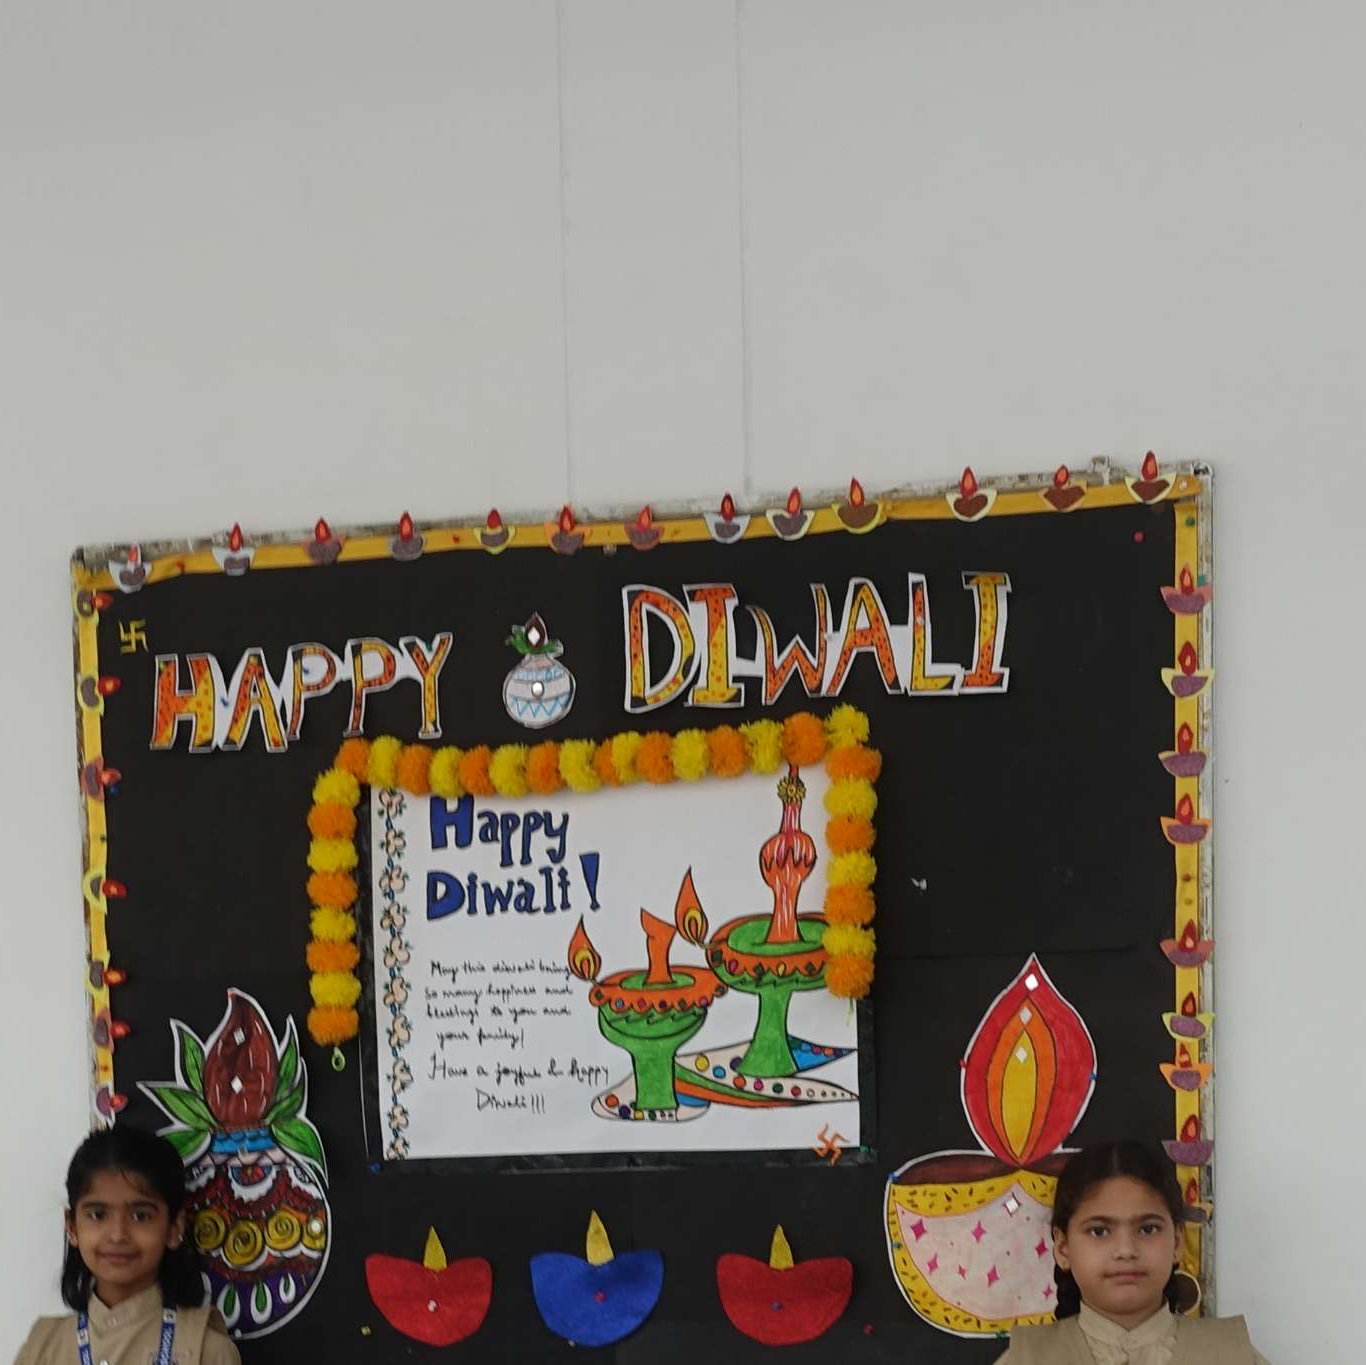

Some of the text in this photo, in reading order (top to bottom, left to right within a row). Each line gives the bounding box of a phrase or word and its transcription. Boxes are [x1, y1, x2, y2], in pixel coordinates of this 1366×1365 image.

[150, 571, 1012, 753] HAPPY DIWALI
[429, 792, 570, 867] Happy
[430, 960, 460, 984] May
[462, 960, 486, 974] this
[538, 959, 571, 982] bring
[442, 989, 483, 1005] many
[486, 982, 537, 1004] happiness
[544, 984, 573, 996] and
[490, 1004, 504, 1017] to
[508, 1006, 536, 1024] you
[543, 1003, 571, 1016] and
[436, 1031, 470, 1051] your
[426, 1051, 469, 1081] Have
[476, 1064, 489, 1077] a
[495, 1061, 542, 1086] joyful
[569, 1056, 610, 1088] happy
[160, 1325, 174, 1365] SCHOOL
